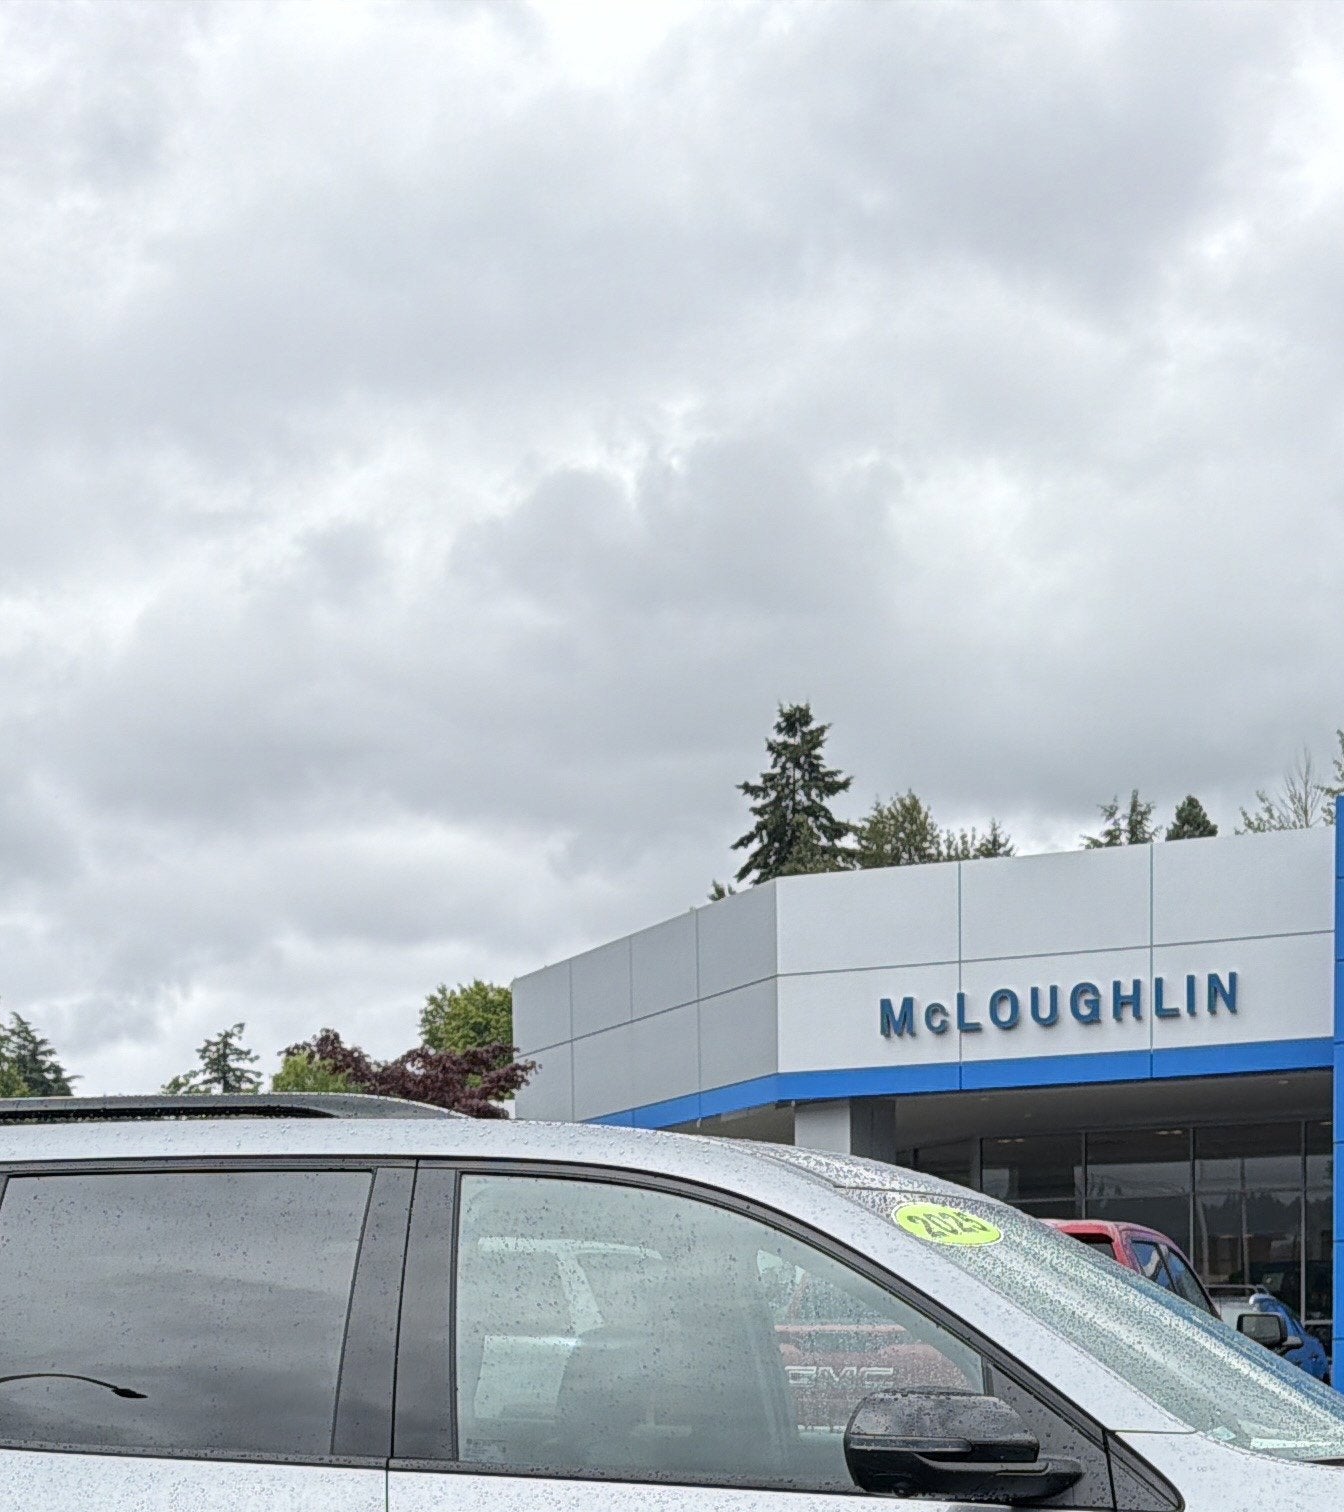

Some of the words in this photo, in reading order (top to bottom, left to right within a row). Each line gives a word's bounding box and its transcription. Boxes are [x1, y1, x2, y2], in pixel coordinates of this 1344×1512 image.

[879, 971, 1238, 1038] McLOUGHLIN
[906, 1211, 990, 1237] 2025
[785, 1366, 894, 1388] GMC
